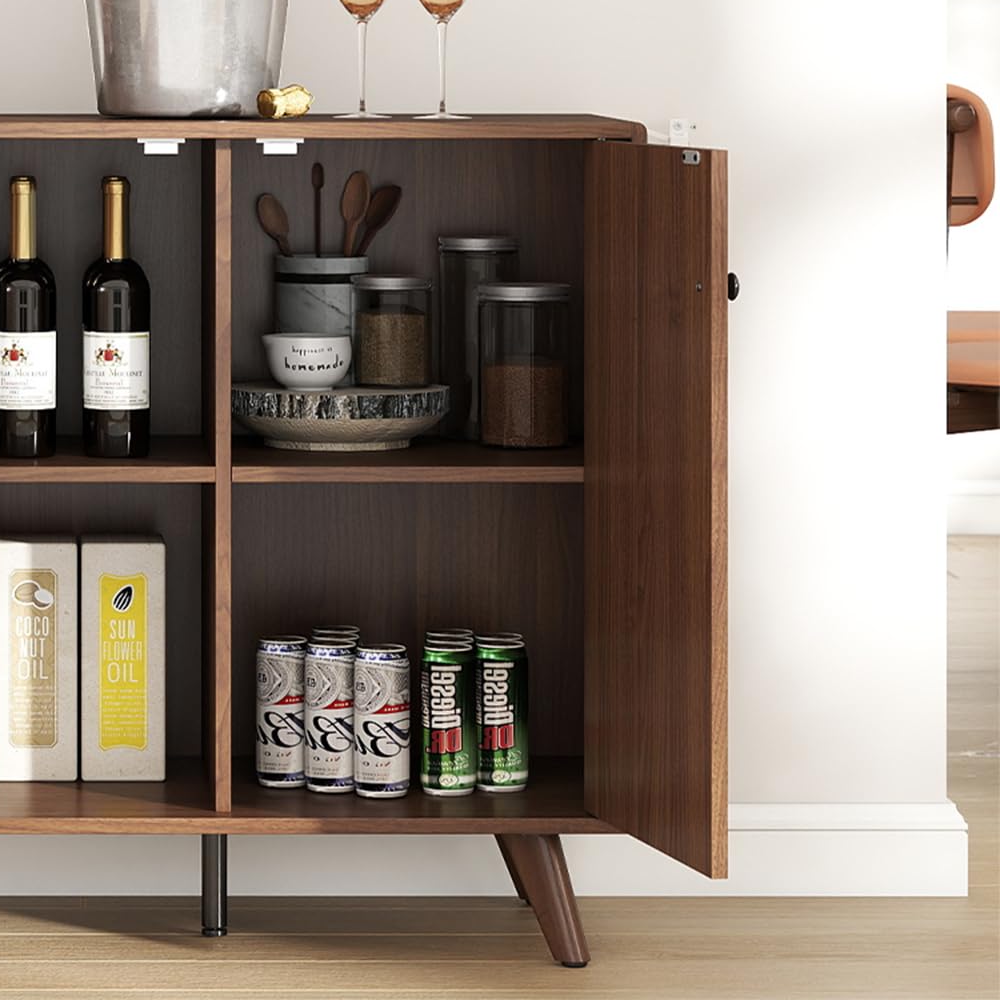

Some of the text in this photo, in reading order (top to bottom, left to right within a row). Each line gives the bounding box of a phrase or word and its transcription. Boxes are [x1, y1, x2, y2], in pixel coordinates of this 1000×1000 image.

[284, 353, 344, 372] homemade
[15, 615, 50, 637] COCO
[109, 619, 136, 640] SUN
[19, 638, 47, 658] NUT
[102, 641, 143, 661] FLOWER
[18, 659, 49, 680] OIL
[107, 662, 139, 683] OIL
